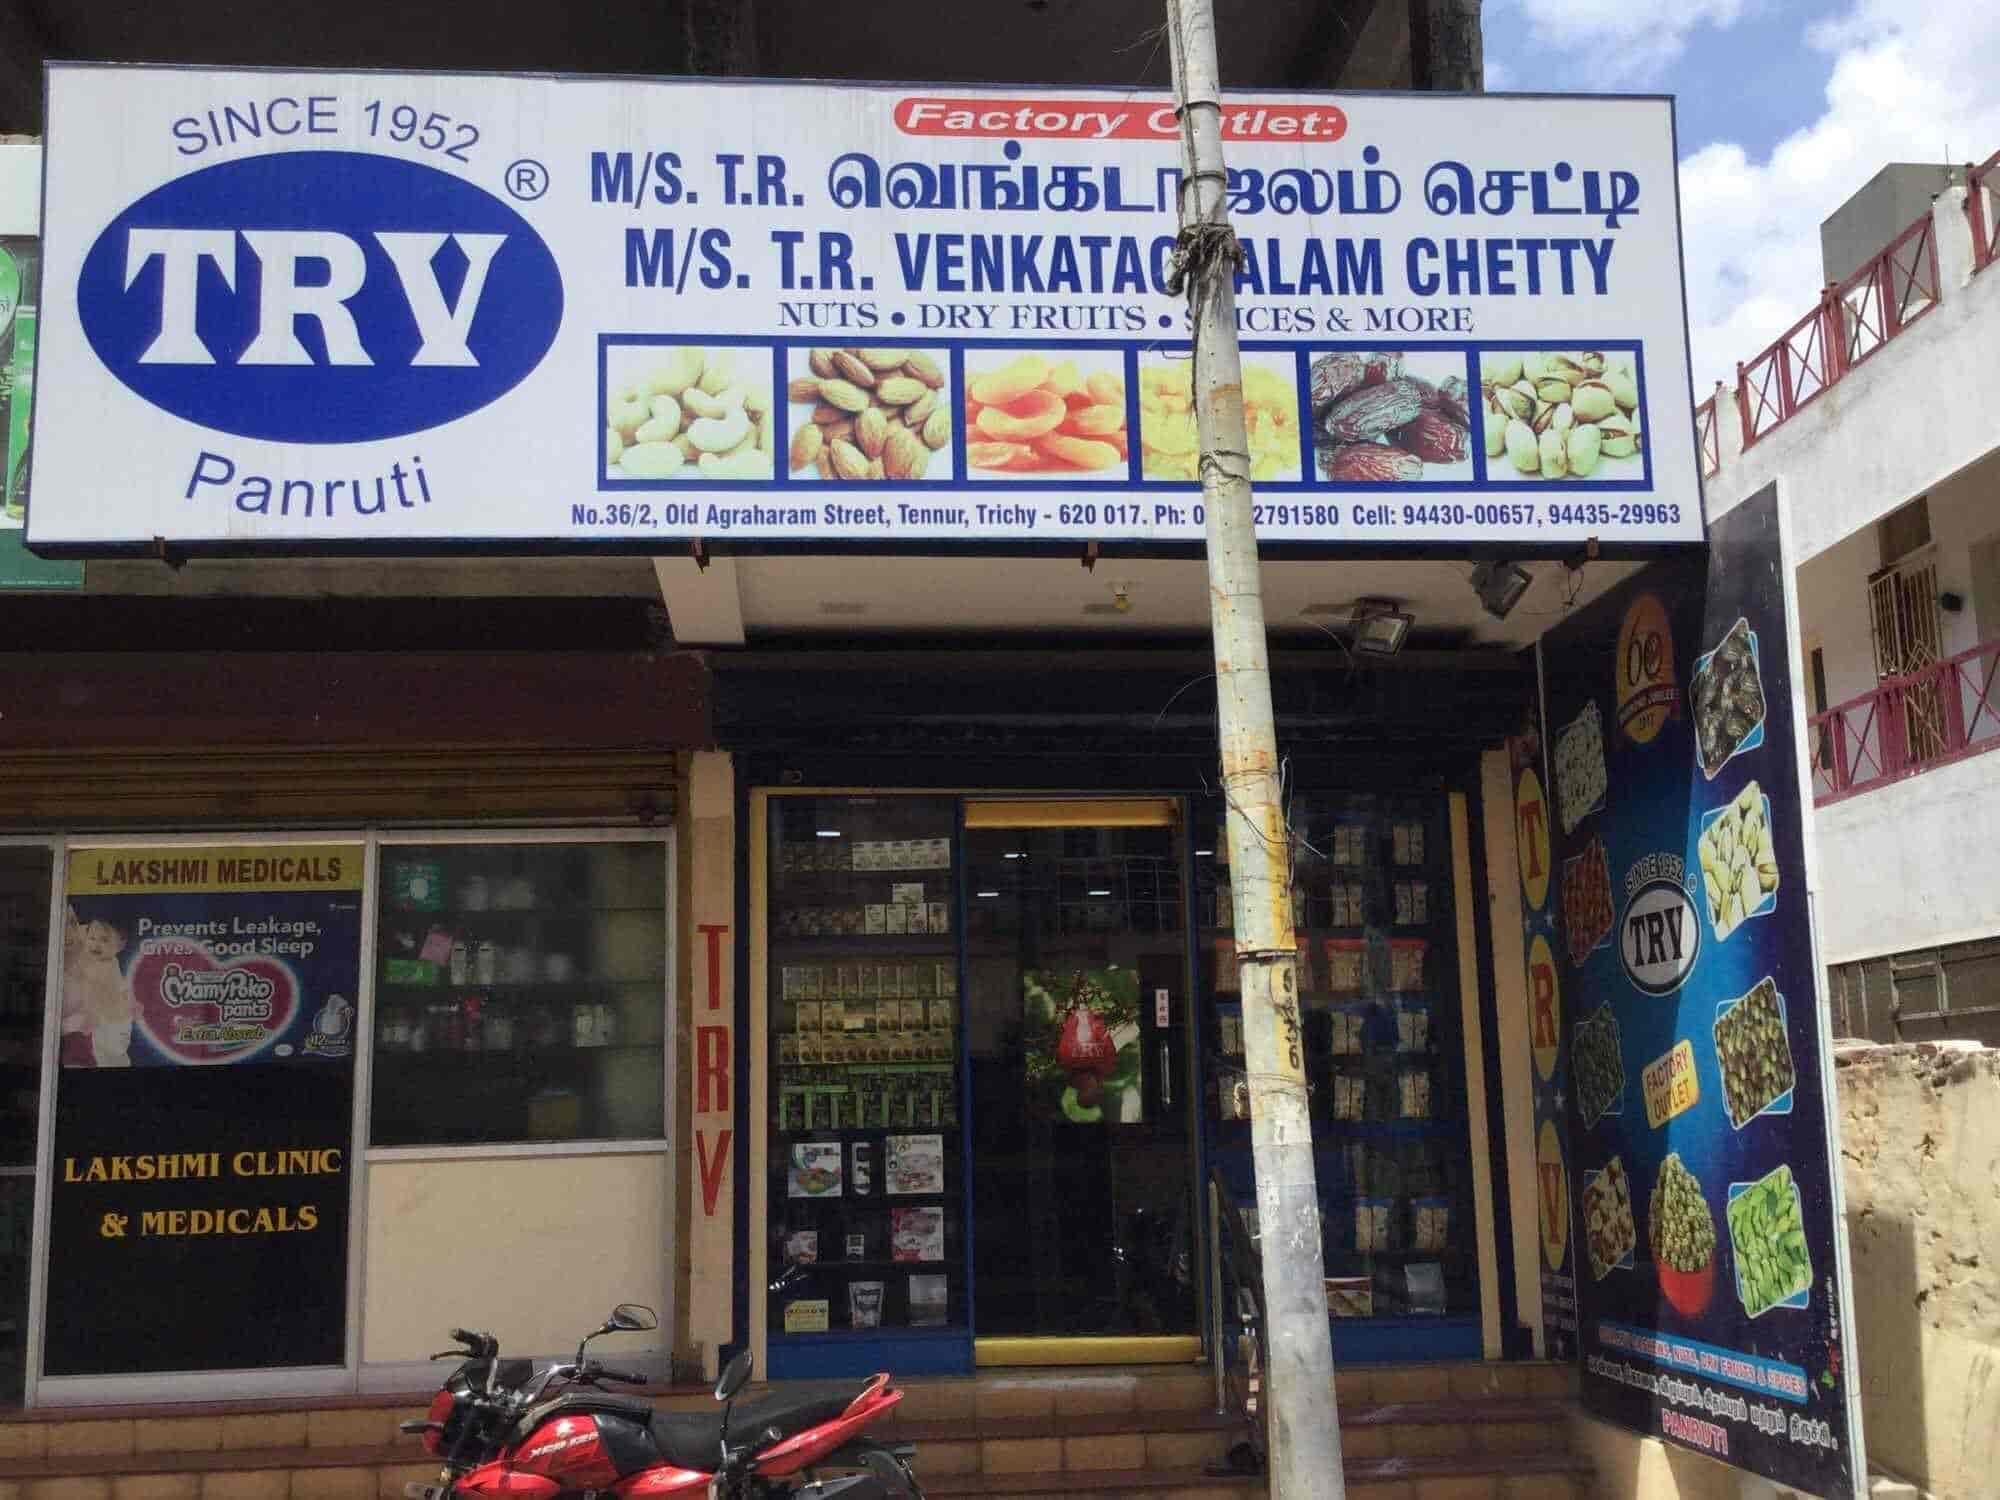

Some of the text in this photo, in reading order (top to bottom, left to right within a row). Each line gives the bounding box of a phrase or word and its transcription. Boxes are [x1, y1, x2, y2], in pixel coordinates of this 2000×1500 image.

[173, 97, 480, 162] SINCE 1952
[906, 104, 1336, 138] Factory Otlet:
[590, 152, 698, 209] M/S.
[716, 154, 804, 207] T.R.
[1424, 161, 1640, 229] செட்டி
[625, 228, 1614, 297] M/S. T.R. VENKATACALAM CHETTY
[124, 228, 510, 368] TRV
[778, 302, 1474, 334] NUTS DRY FRUITS ICES & MORE
[185, 451, 432, 518] Panruti
[572, 503, 658, 528] No.36/2,
[666, 504, 698, 525] Old
[706, 504, 816, 529] Agraharam
[824, 503, 891, 527] Street,
[897, 504, 969, 527] Tennur,
[976, 504, 1036, 528] Trichy
[1059, 505, 1096, 525] 620
[1104, 505, 1147, 525] 017.
[1155, 505, 1185, 525] Ph:
[1353, 505, 1396, 525] Cell:
[1403, 504, 1542, 527] 94430-00657,
[1549, 504, 1680, 524] 94435-29963
[97, 857, 341, 886] LAKSHMI MEDICALS
[138, 917, 321, 938] Prevents Leakage,
[206, 939, 255, 955] Good
[261, 938, 314, 958] Sleep
[1630, 904, 1684, 967] TRV
[222, 1002, 270, 1021] pants
[696, 924, 732, 1216] TRV
[1646, 1046, 1689, 1088] FACTORY
[1654, 1077, 1689, 1120] OUTLET
[65, 1149, 341, 1182] LAKSHMI CLINIC
[100, 1206, 318, 1237] & MEDICALS
[1661, 1407, 1729, 1457] PANRUTI
